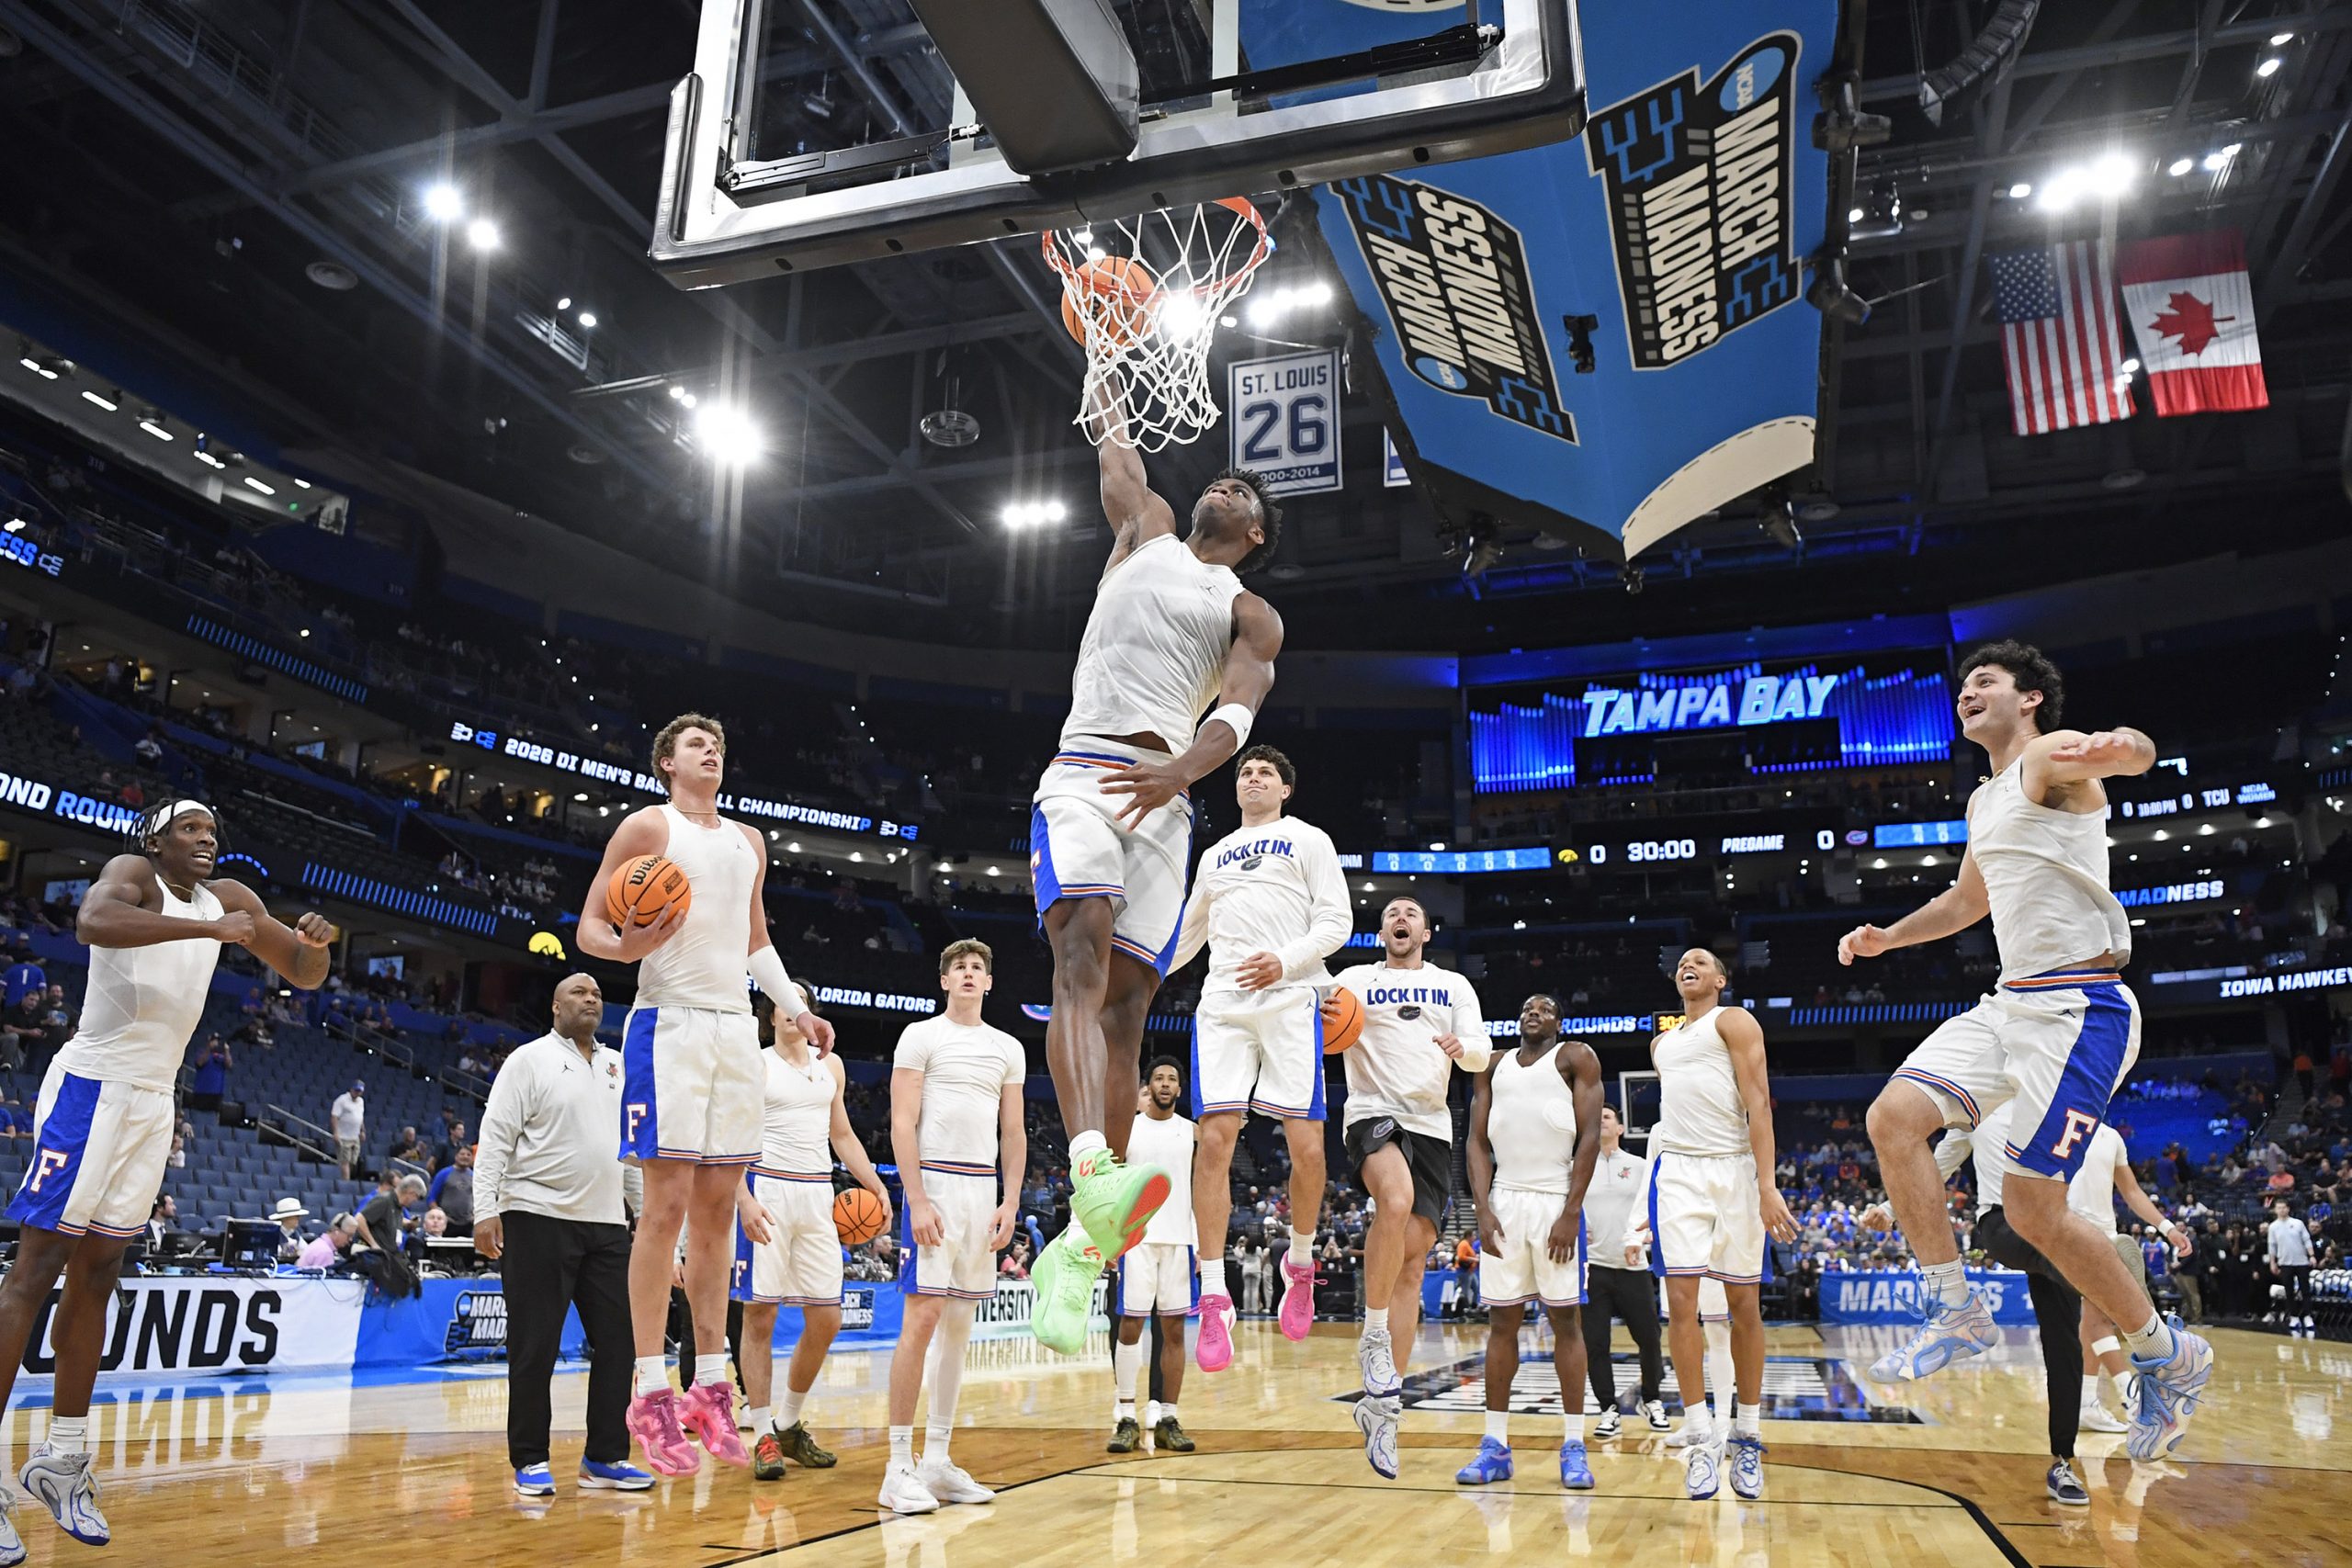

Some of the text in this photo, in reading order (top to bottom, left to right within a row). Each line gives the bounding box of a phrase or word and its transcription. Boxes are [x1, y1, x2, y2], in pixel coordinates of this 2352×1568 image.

[1713, 96, 1780, 271] MARCH
[1642, 162, 1719, 360] MADNESS
[1366, 231, 1468, 368] MARCH
[1416, 189, 1526, 376] MADNESS
[1242, 365, 1327, 395] ST. LOUIS
[1242, 392, 1328, 464] 26
[1261, 466, 1320, 482] 000-2014
[1582, 674, 1838, 738] TAMPA BAY
[504, 738, 553, 765] 2026
[555, 751, 580, 772] DI
[581, 759, 632, 785] MEN'S
[739, 796, 872, 832] CHAMPIONSHIP
[2240, 783, 2269, 794] NCAA
[2121, 801, 2133, 818] 0
[2181, 794, 2193, 809] 0
[2201, 788, 2230, 807] TCU
[1216, 840, 1295, 870] LOCK IT IN.
[1589, 829, 1835, 864] 0 30:00 PREGAME 0
[875, 992, 936, 1013] GATORS
[1366, 987, 1453, 1008] LOCK IT IN.
[2220, 976, 2275, 998] IOWA
[626, 1103, 648, 1144] F
[2050, 1107, 2098, 1160] F
[29, 1147, 69, 1194] F
[734, 1259, 748, 1289] F
[469, 1295, 508, 1317] MARC
